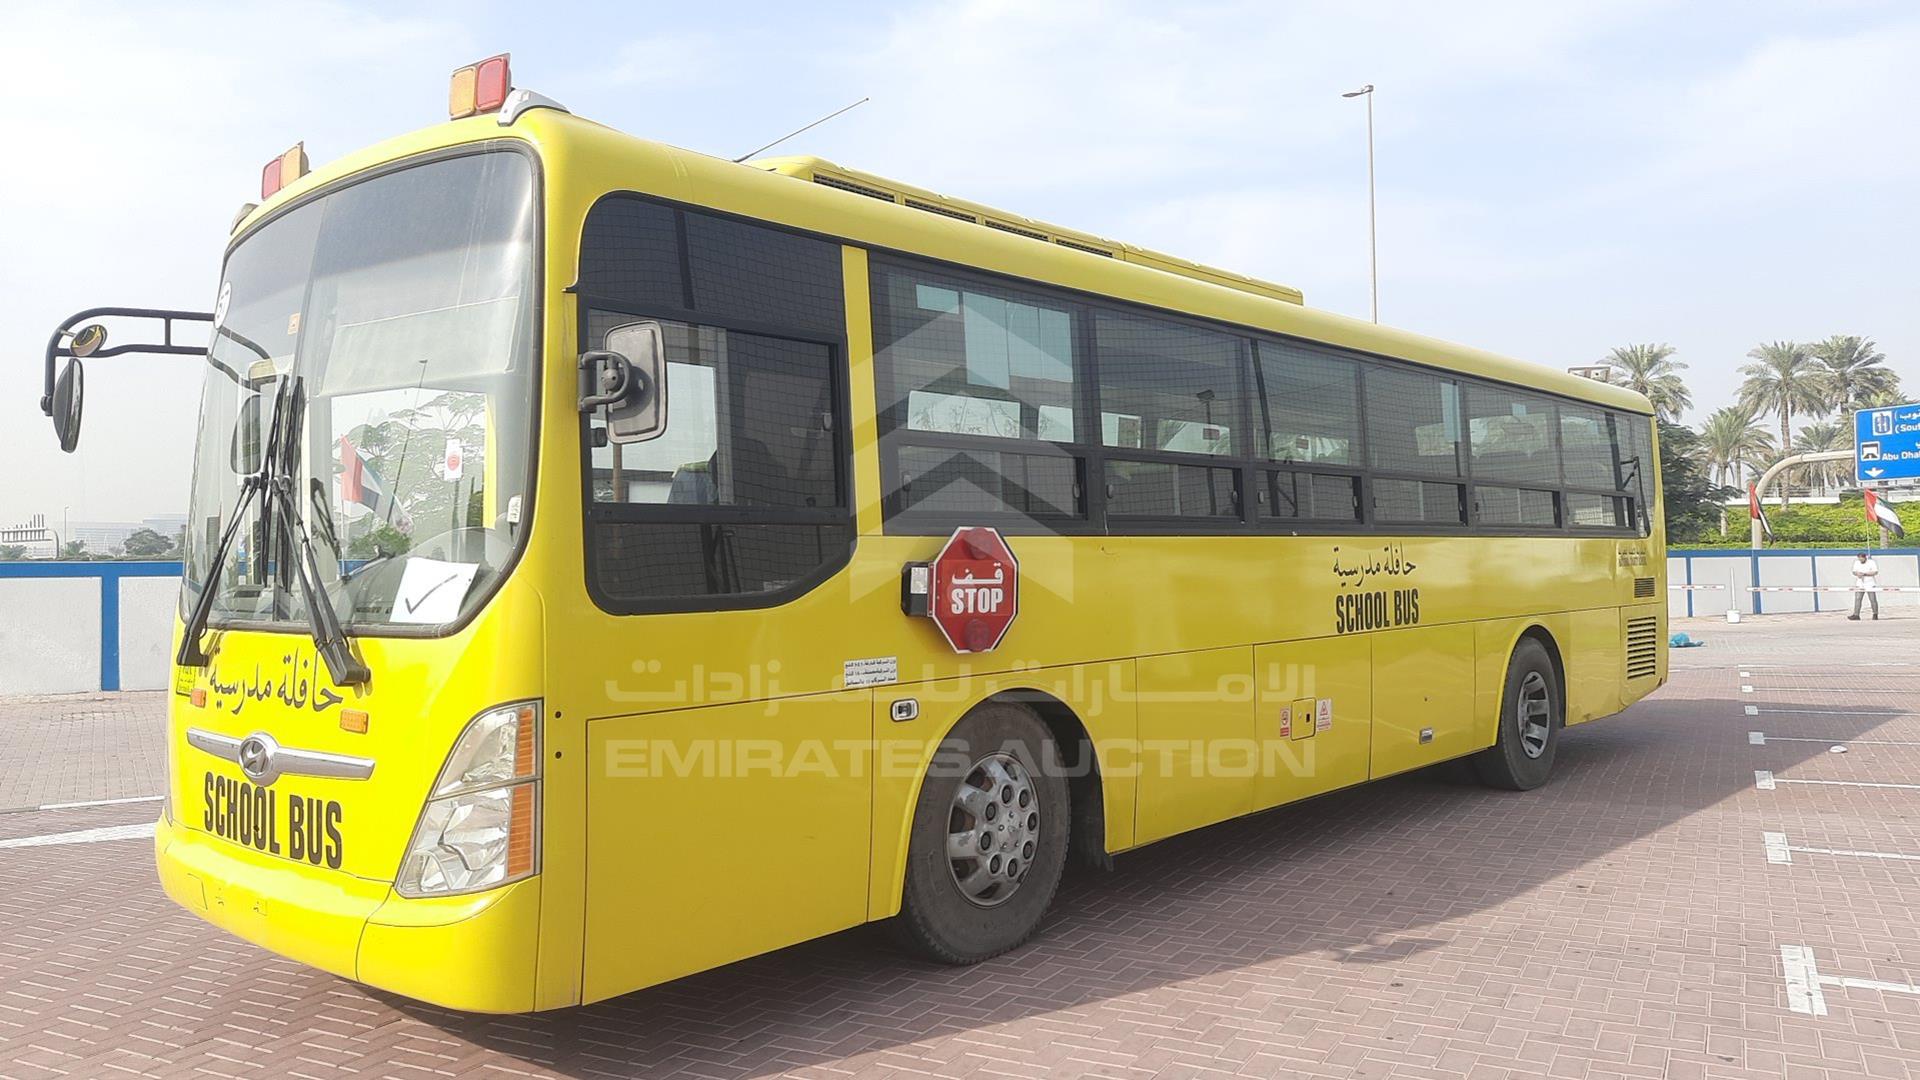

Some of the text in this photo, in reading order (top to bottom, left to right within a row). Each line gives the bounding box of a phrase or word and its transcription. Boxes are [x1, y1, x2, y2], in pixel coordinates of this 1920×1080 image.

[1882, 450, 1920, 461] Abu Dha
[951, 562, 1004, 585] قف
[1333, 541, 1416, 587] حافلة مدرسية
[951, 587, 1004, 615] STOP
[1336, 588, 1419, 634] SCHOOL BUS
[209, 646, 273, 715] مدرسية
[277, 647, 344, 713] حافلة
[204, 771, 343, 870] SCHOOL BUS
